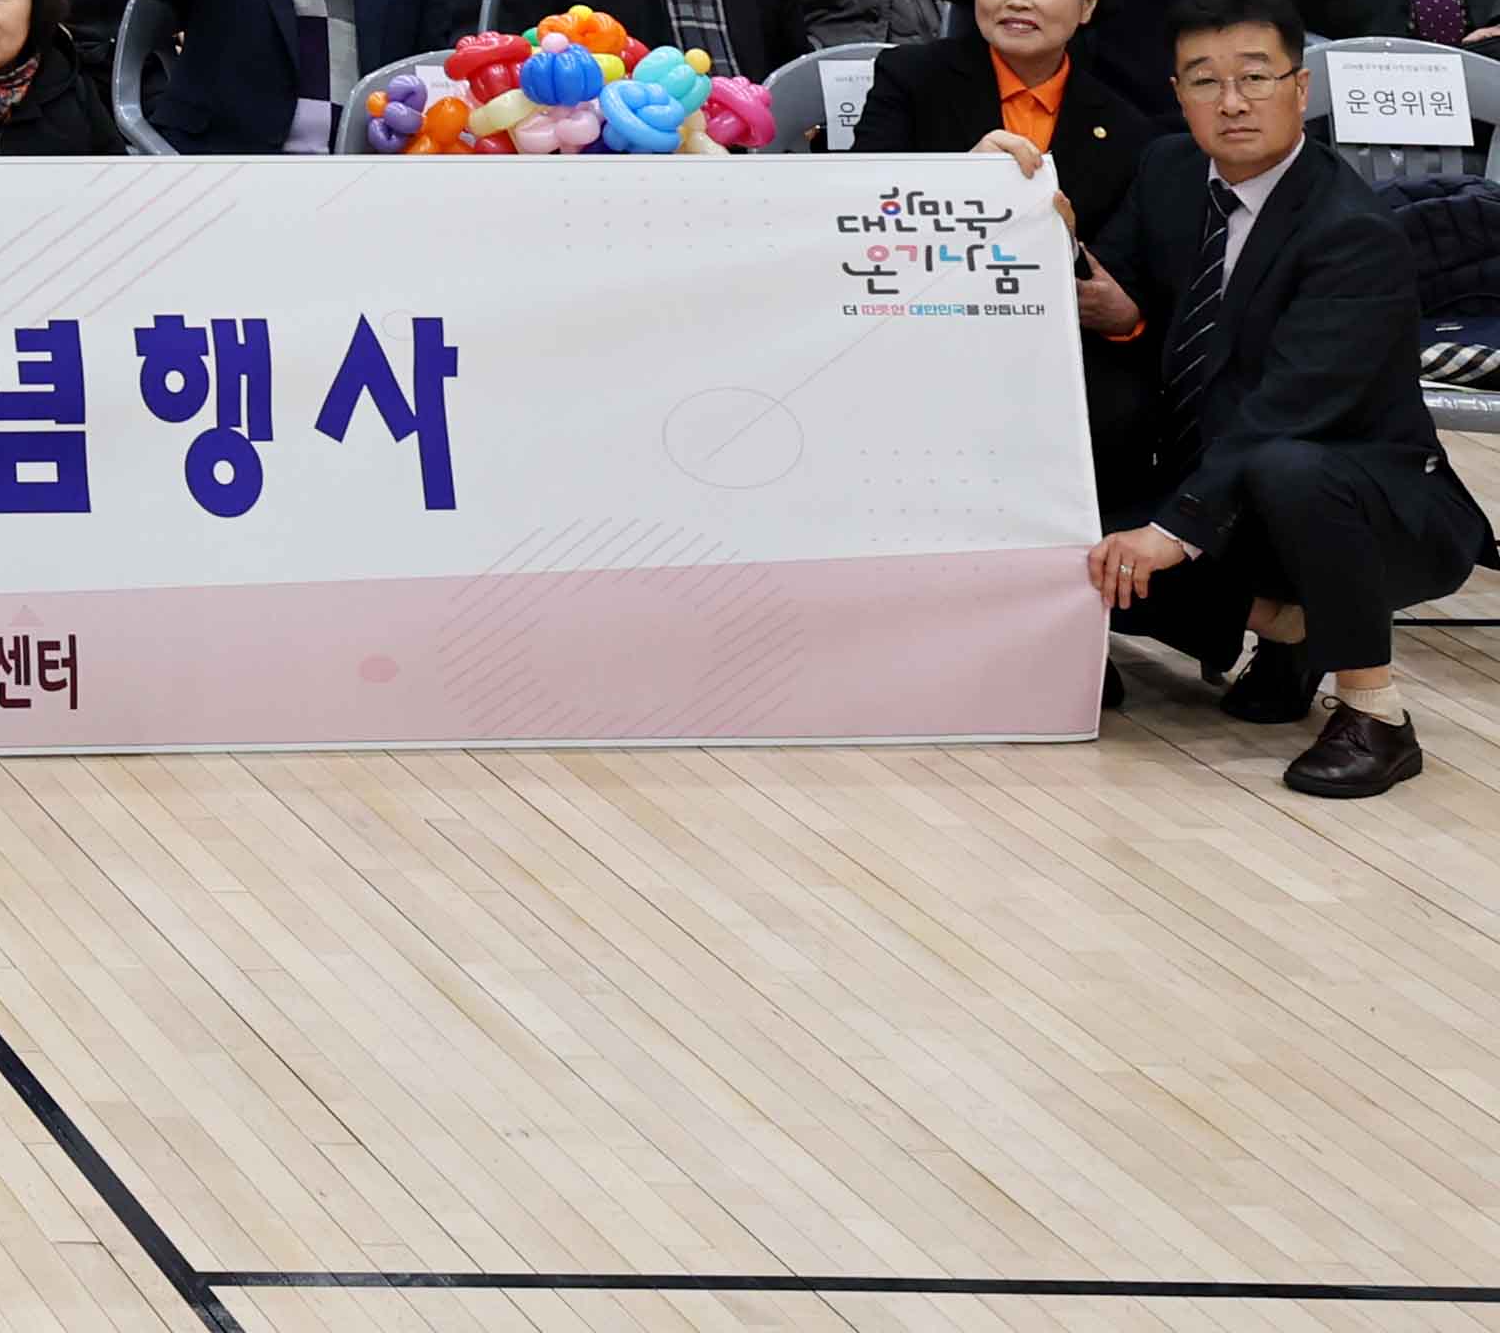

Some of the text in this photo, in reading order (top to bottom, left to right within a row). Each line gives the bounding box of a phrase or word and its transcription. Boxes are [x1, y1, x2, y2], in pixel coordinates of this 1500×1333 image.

[1346, 88, 1455, 118] 운영위원
[836, 186, 1013, 240] 대한민국
[841, 243, 1041, 295] 온기나눔
